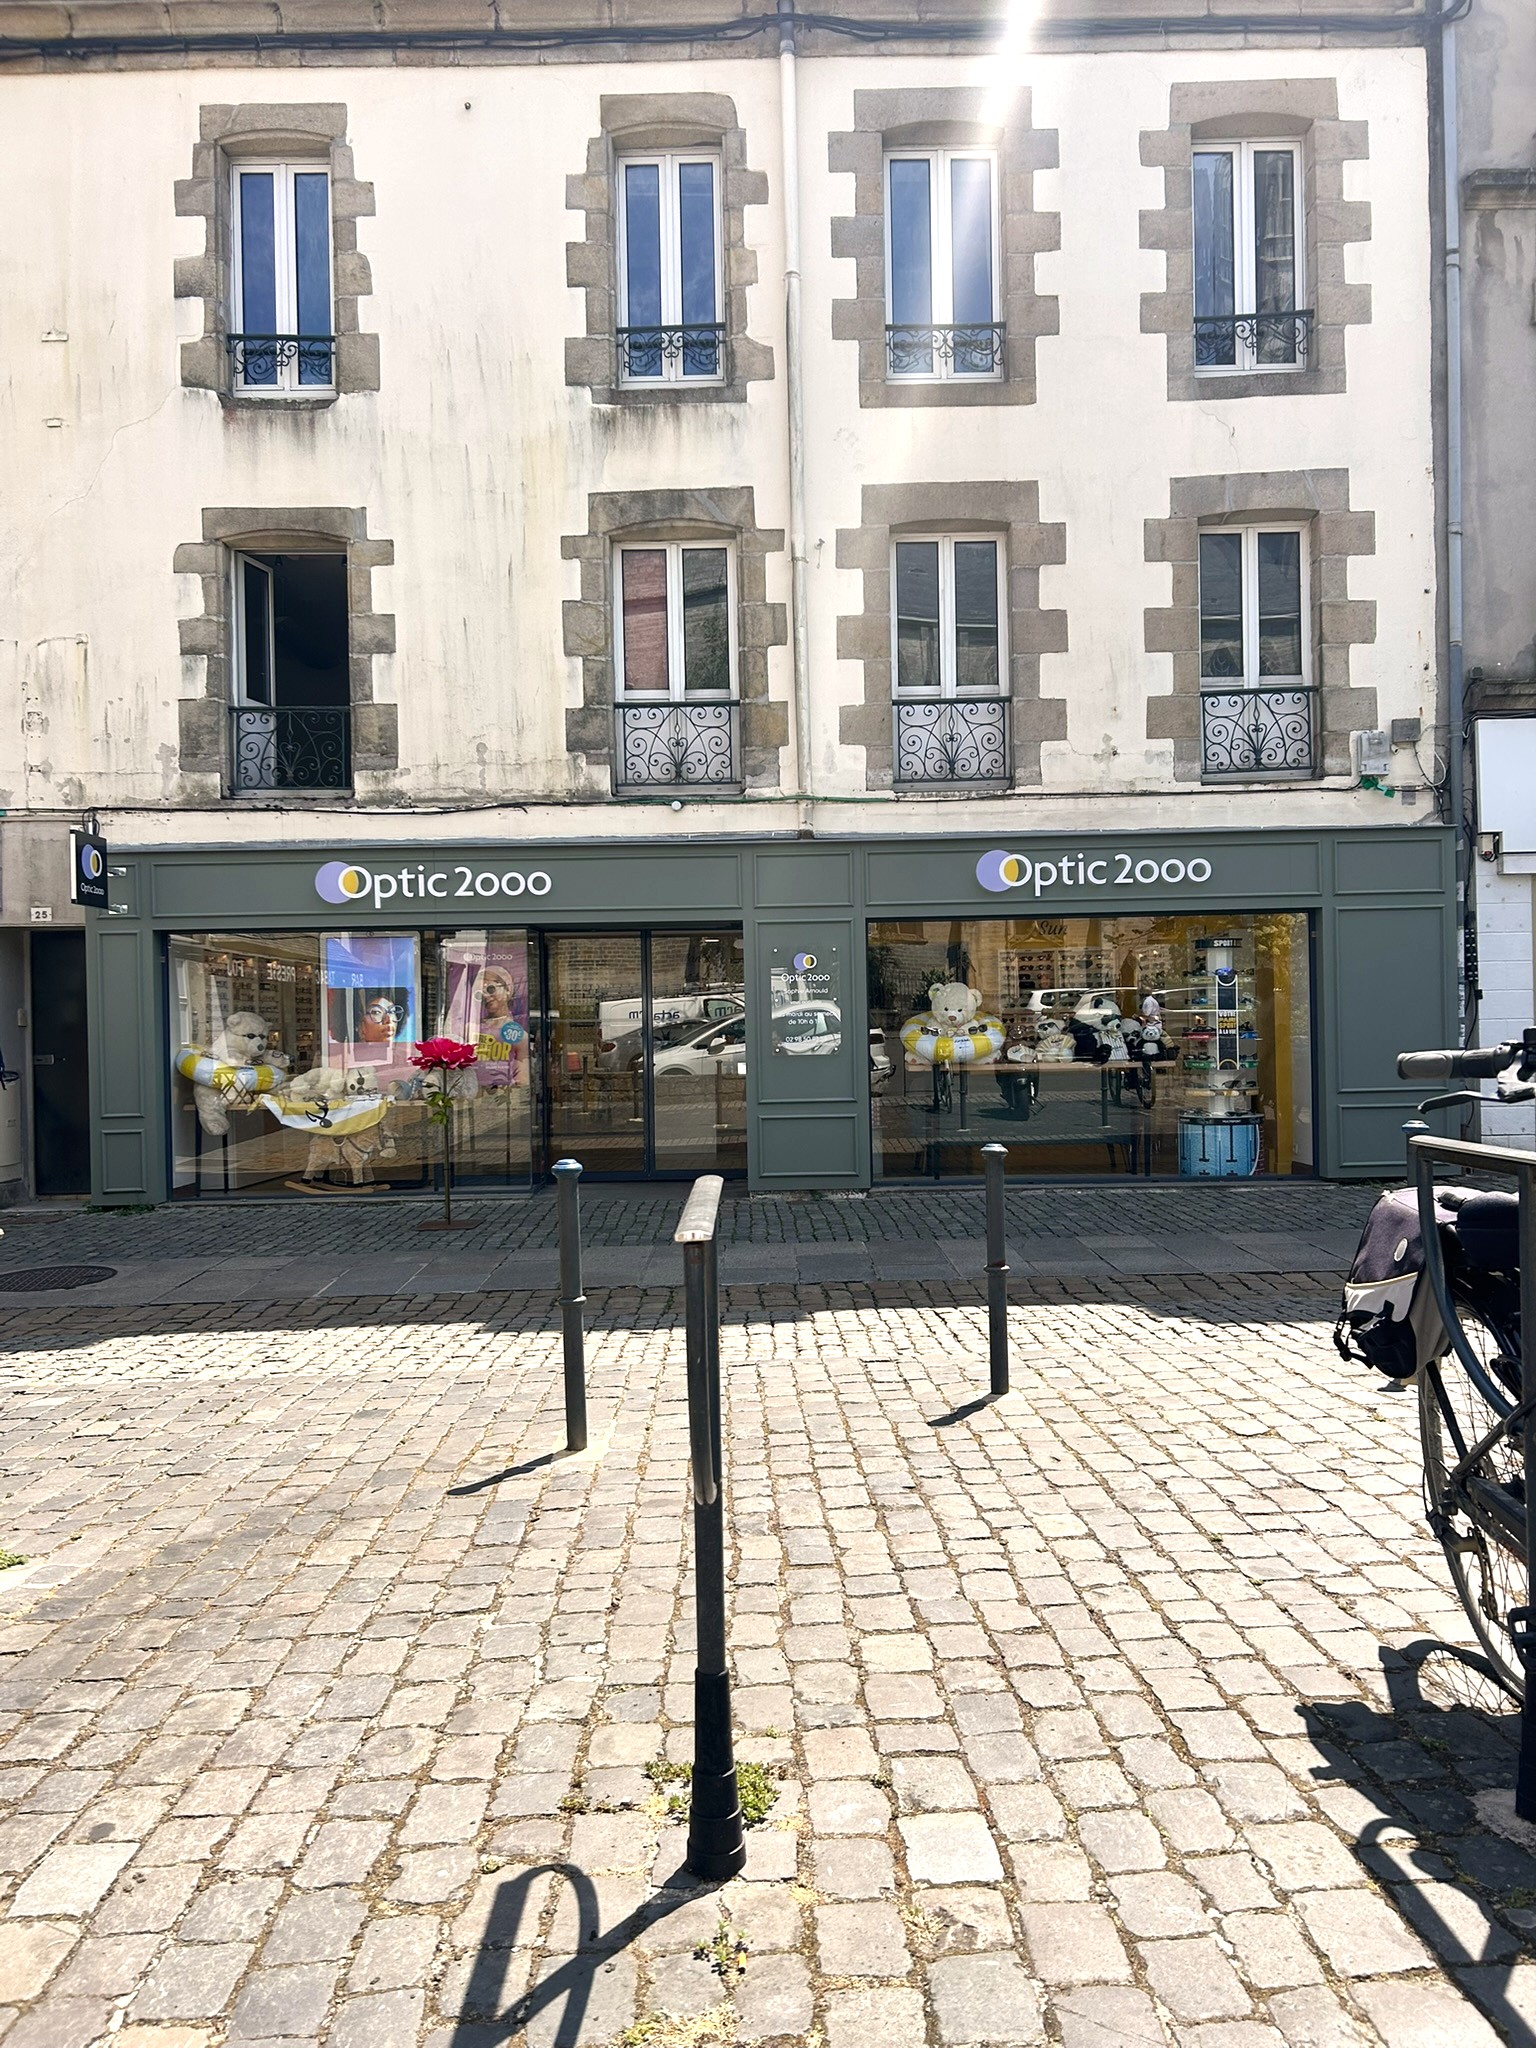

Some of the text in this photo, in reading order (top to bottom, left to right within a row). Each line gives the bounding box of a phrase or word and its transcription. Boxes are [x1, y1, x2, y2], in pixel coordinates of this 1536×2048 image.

[999, 852, 1212, 897] Optic 2000
[81, 882, 105, 895] Optic 2000
[338, 864, 552, 909] Optic 2000
[34, 910, 48, 919] 25
[1039, 920, 1068, 936] Sun
[781, 973, 806, 983] Optic
